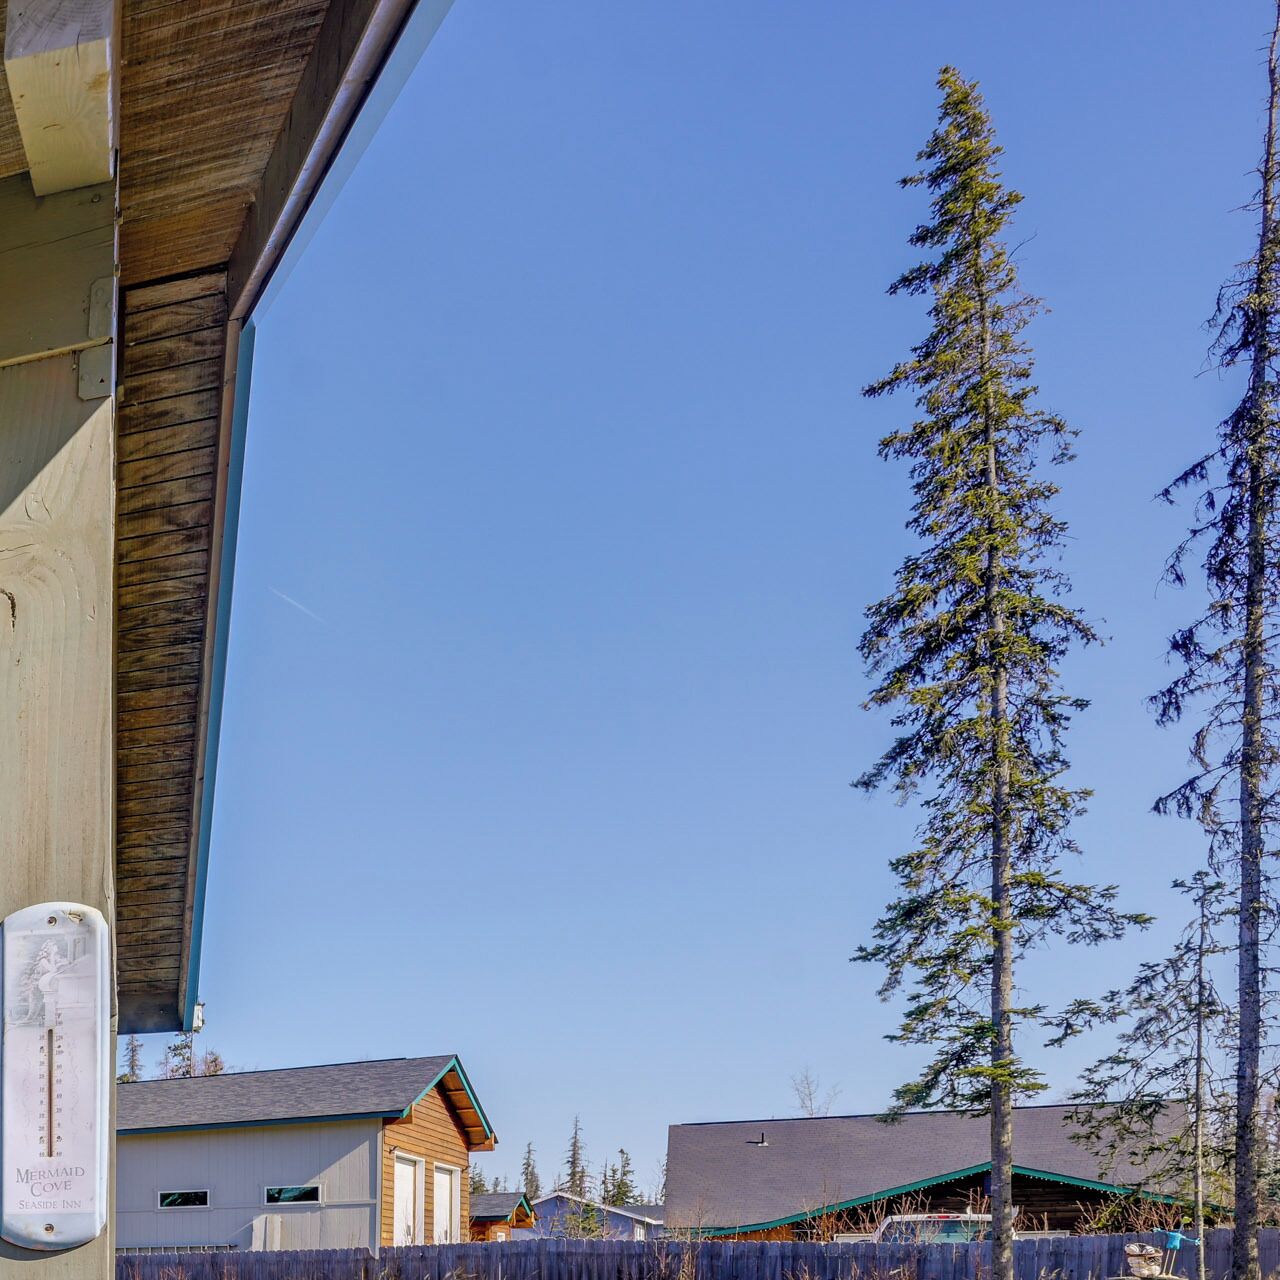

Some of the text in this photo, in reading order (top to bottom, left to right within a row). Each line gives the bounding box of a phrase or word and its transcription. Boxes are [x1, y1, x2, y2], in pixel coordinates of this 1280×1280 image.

[16, 1166, 85, 1184] MERMAID
[30, 1180, 72, 1197] COVE
[18, 1199, 81, 1210] SEASIDE INN
